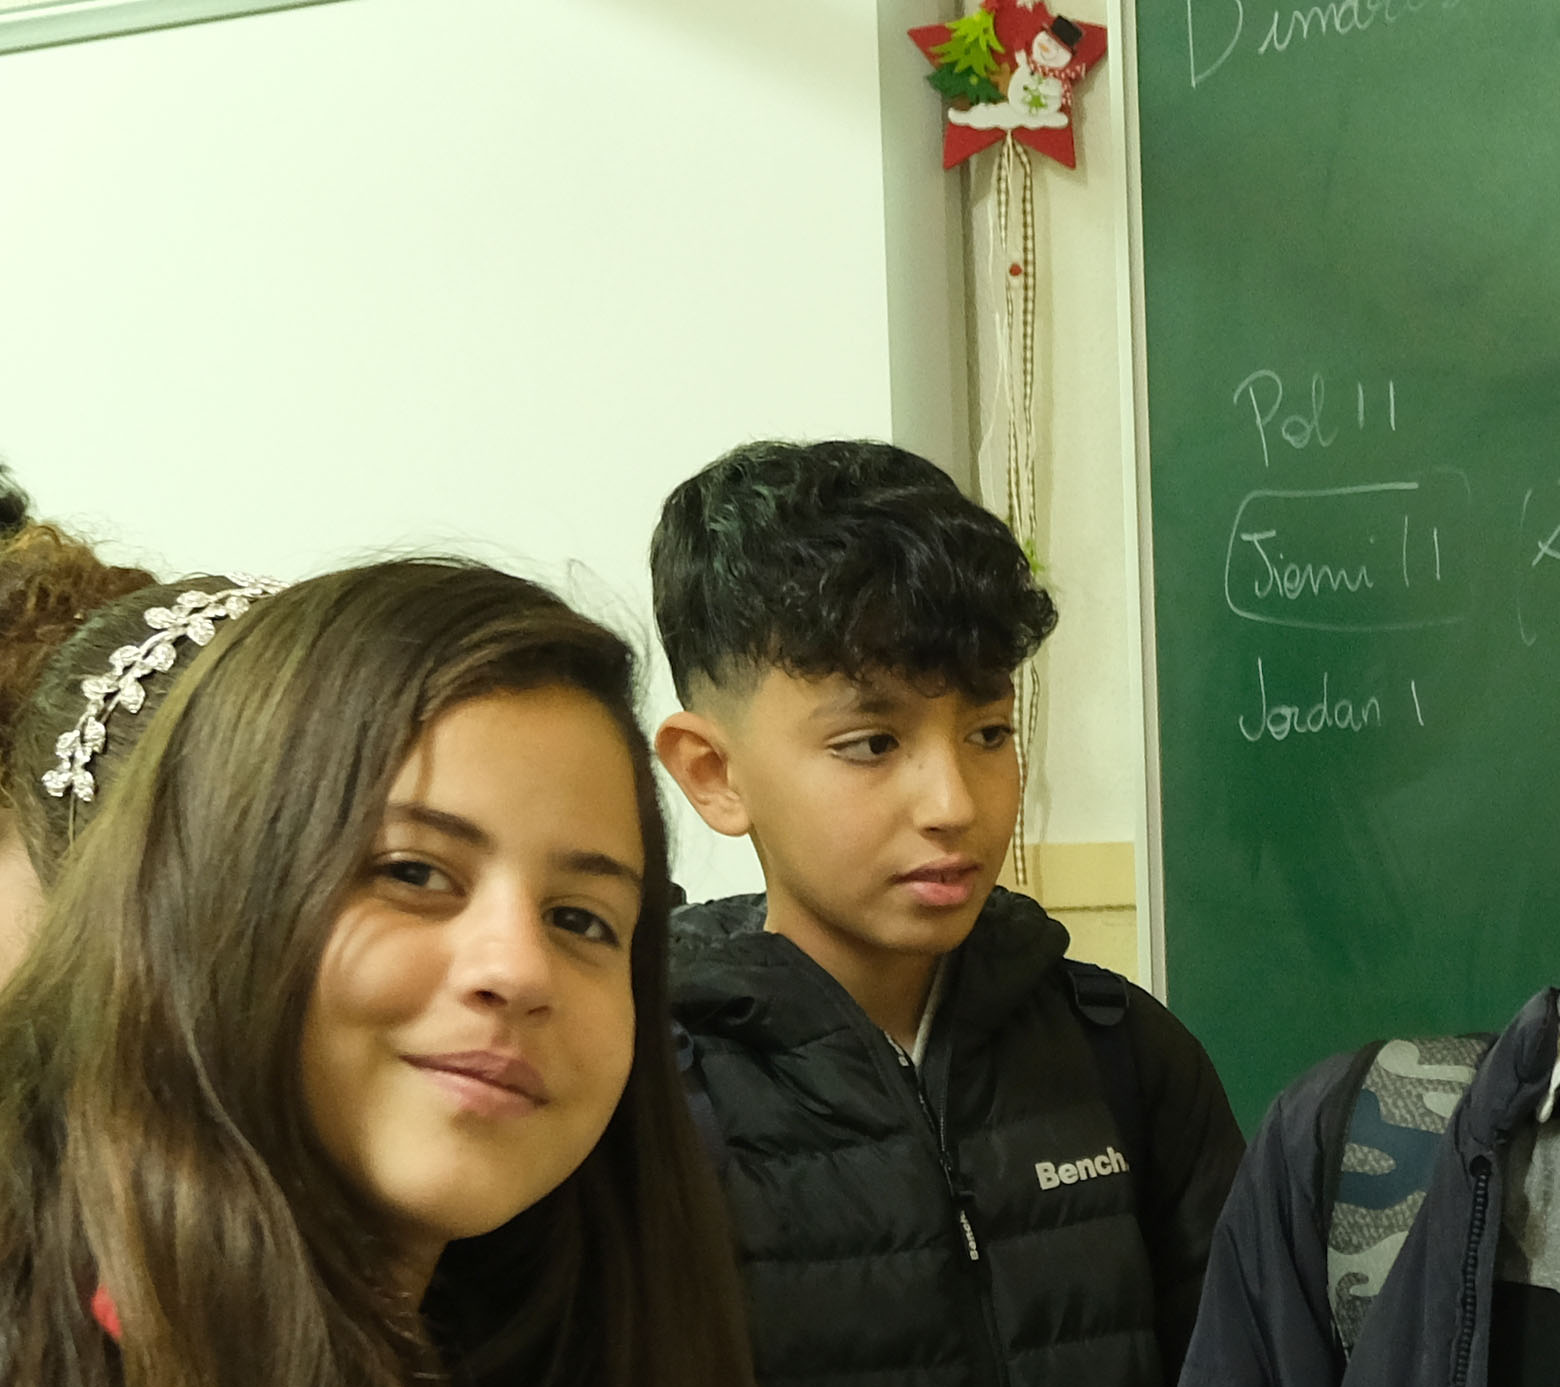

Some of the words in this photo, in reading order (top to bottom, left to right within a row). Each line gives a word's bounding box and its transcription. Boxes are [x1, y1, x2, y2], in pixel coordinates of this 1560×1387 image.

[1234, 369, 1338, 467] Pol
[1239, 656, 1382, 742] Jordan
[1034, 1146, 1129, 1191] Bench
